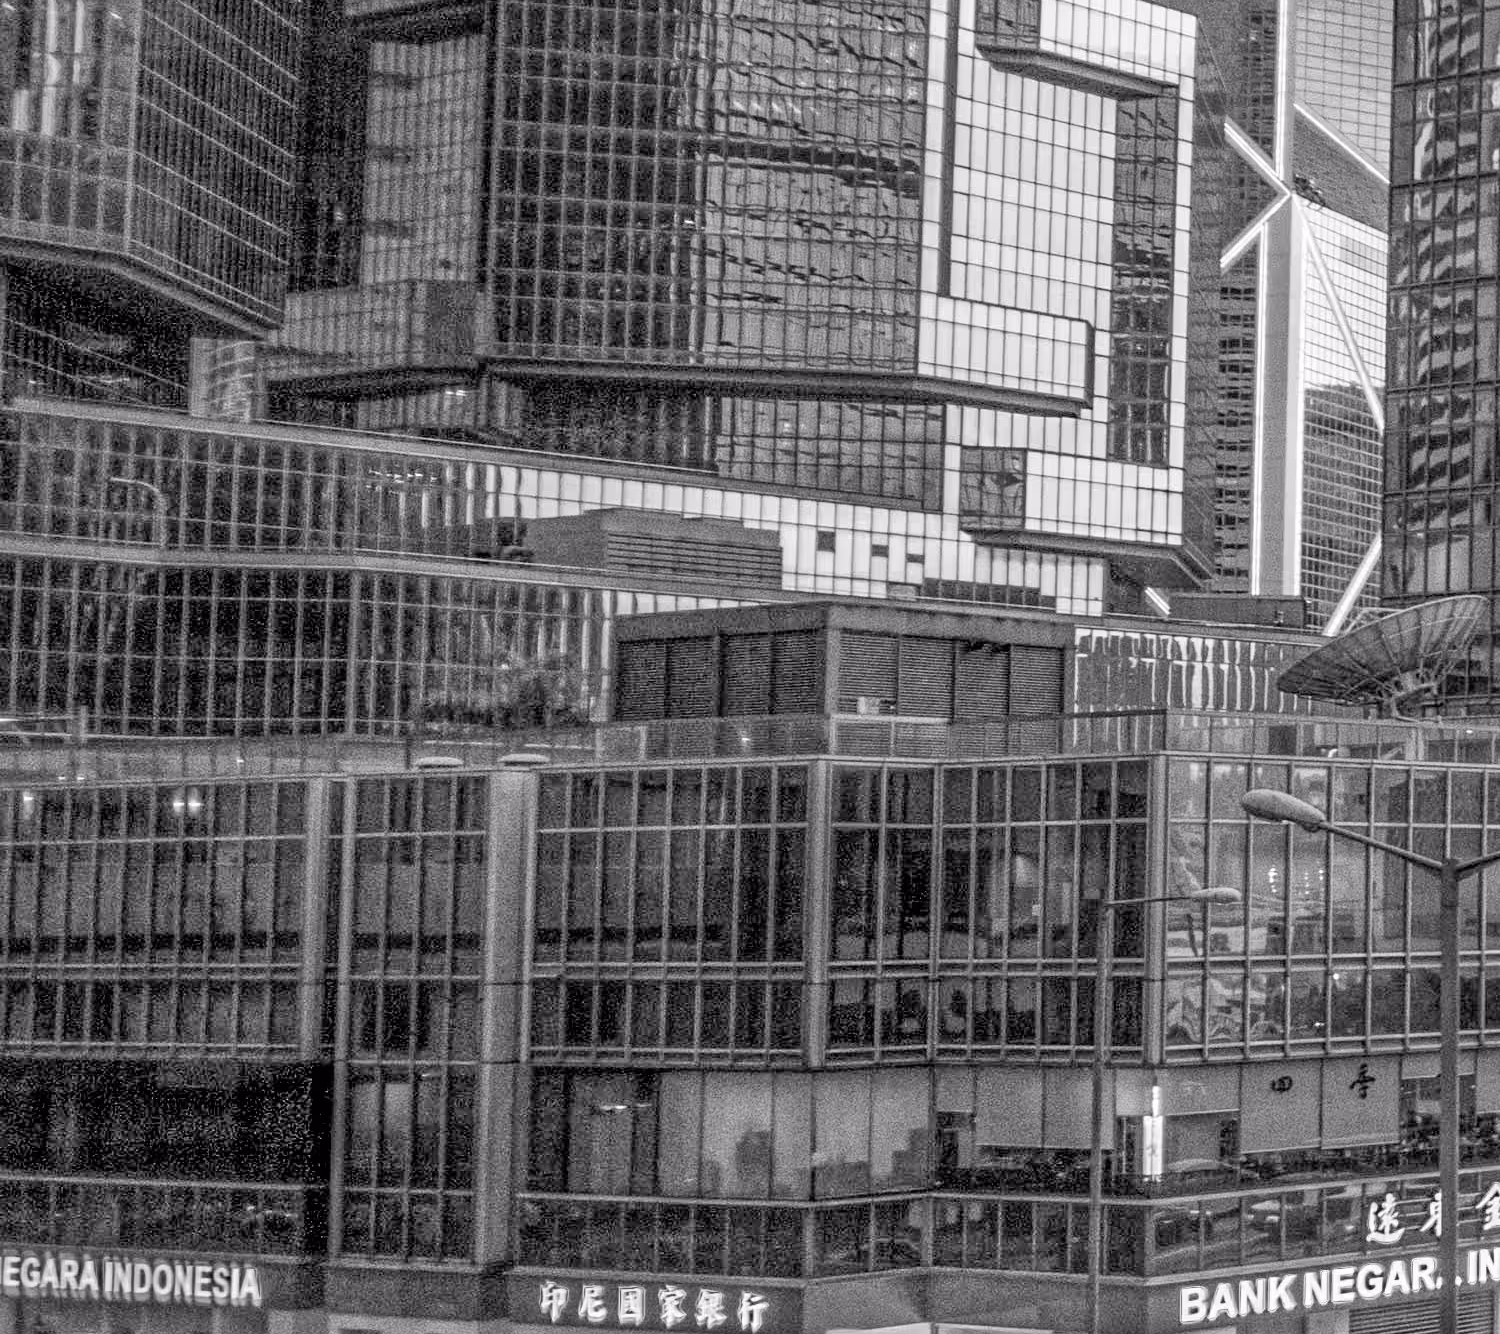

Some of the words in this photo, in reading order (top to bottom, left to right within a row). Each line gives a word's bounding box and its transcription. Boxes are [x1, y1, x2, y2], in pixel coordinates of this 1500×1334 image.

[0, 1255, 99, 1293] EGARA
[103, 1259, 262, 1305] INDONESIA
[1179, 1274, 1298, 1324] BANK
[1303, 1256, 1461, 1308] NEGAR
